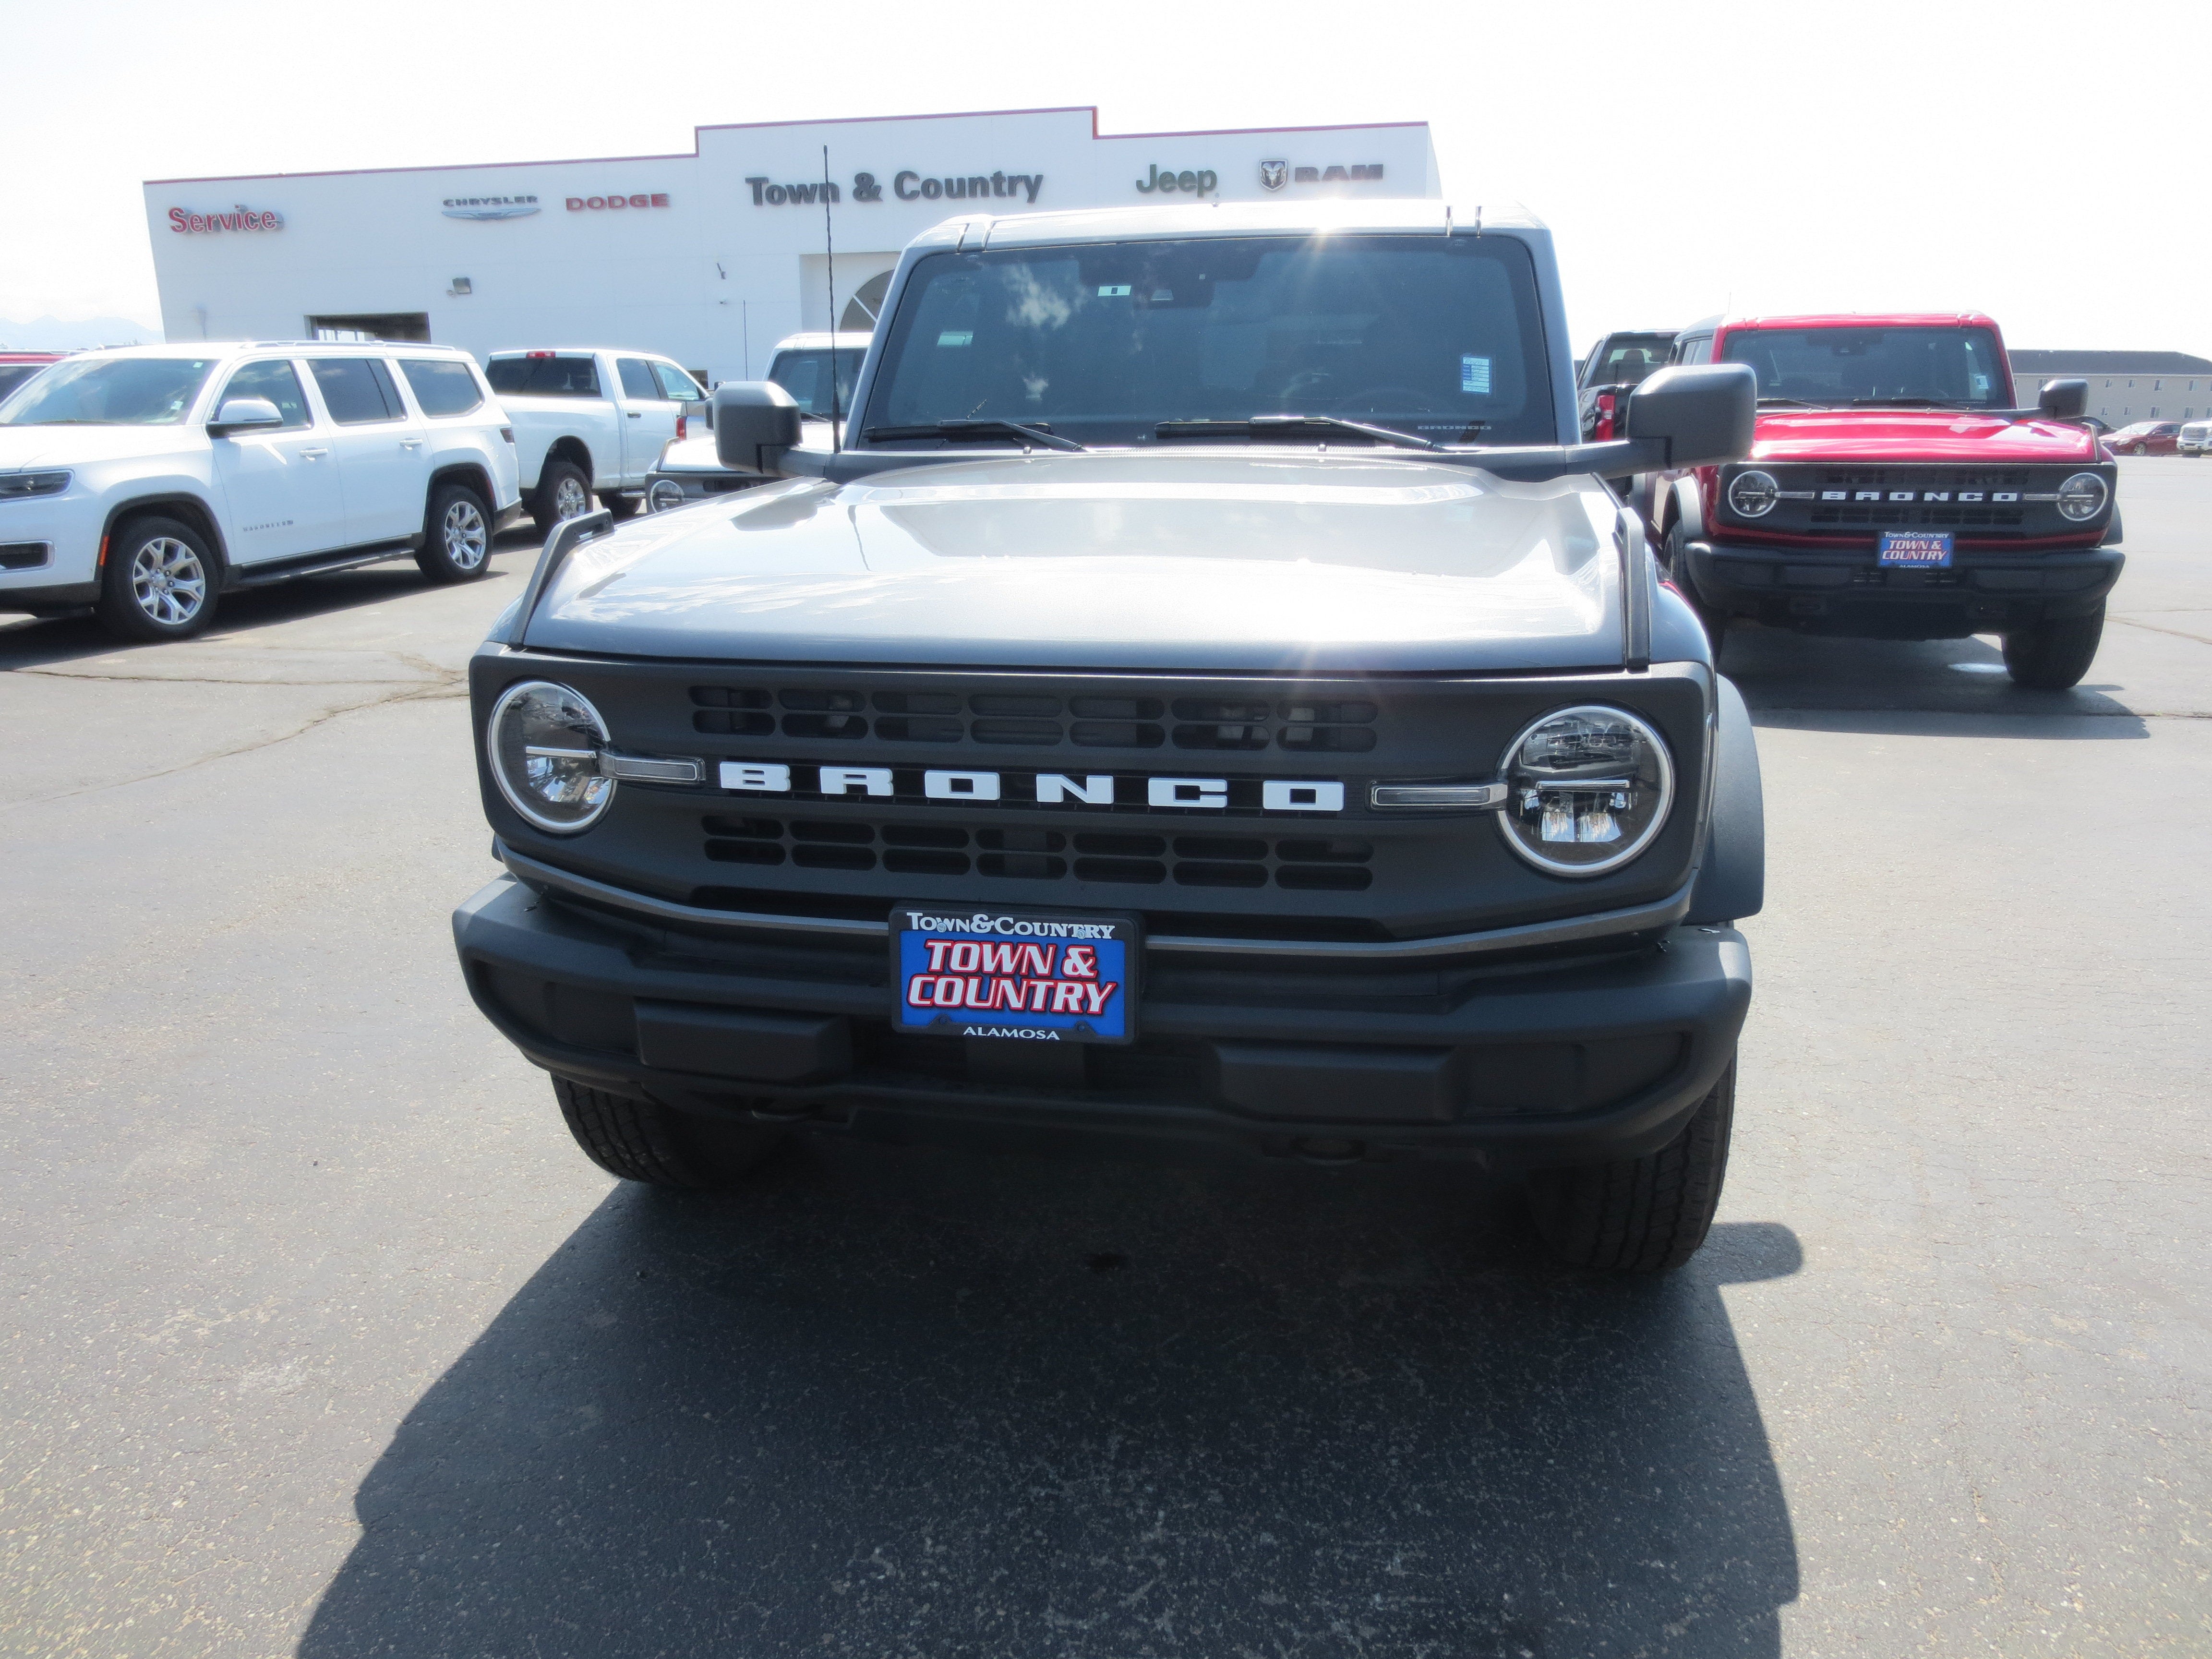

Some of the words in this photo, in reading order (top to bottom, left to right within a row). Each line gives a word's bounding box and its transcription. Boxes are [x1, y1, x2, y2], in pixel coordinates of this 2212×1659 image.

[1136, 164, 1217, 198] Jeep
[1295, 164, 1383, 182] RAM
[745, 176, 840, 206] Town
[852, 172, 883, 203] &
[894, 170, 1044, 204] Country
[443, 195, 538, 207] CHRYSLER
[565, 193, 669, 211] DODGE
[168, 204, 277, 233] Service
[1821, 491, 2018, 502] BRONCO
[1888, 540, 1930, 550] TOWN
[1931, 540, 1943, 550] &
[1882, 550, 1948, 561] COUNTRY
[719, 761, 1345, 811] BRONCO
[925, 939, 1056, 976] TOWN
[1062, 946, 1098, 978] &
[907, 974, 1117, 1015] COUNTRY
[963, 1026, 1060, 1041] ALAMOSA
